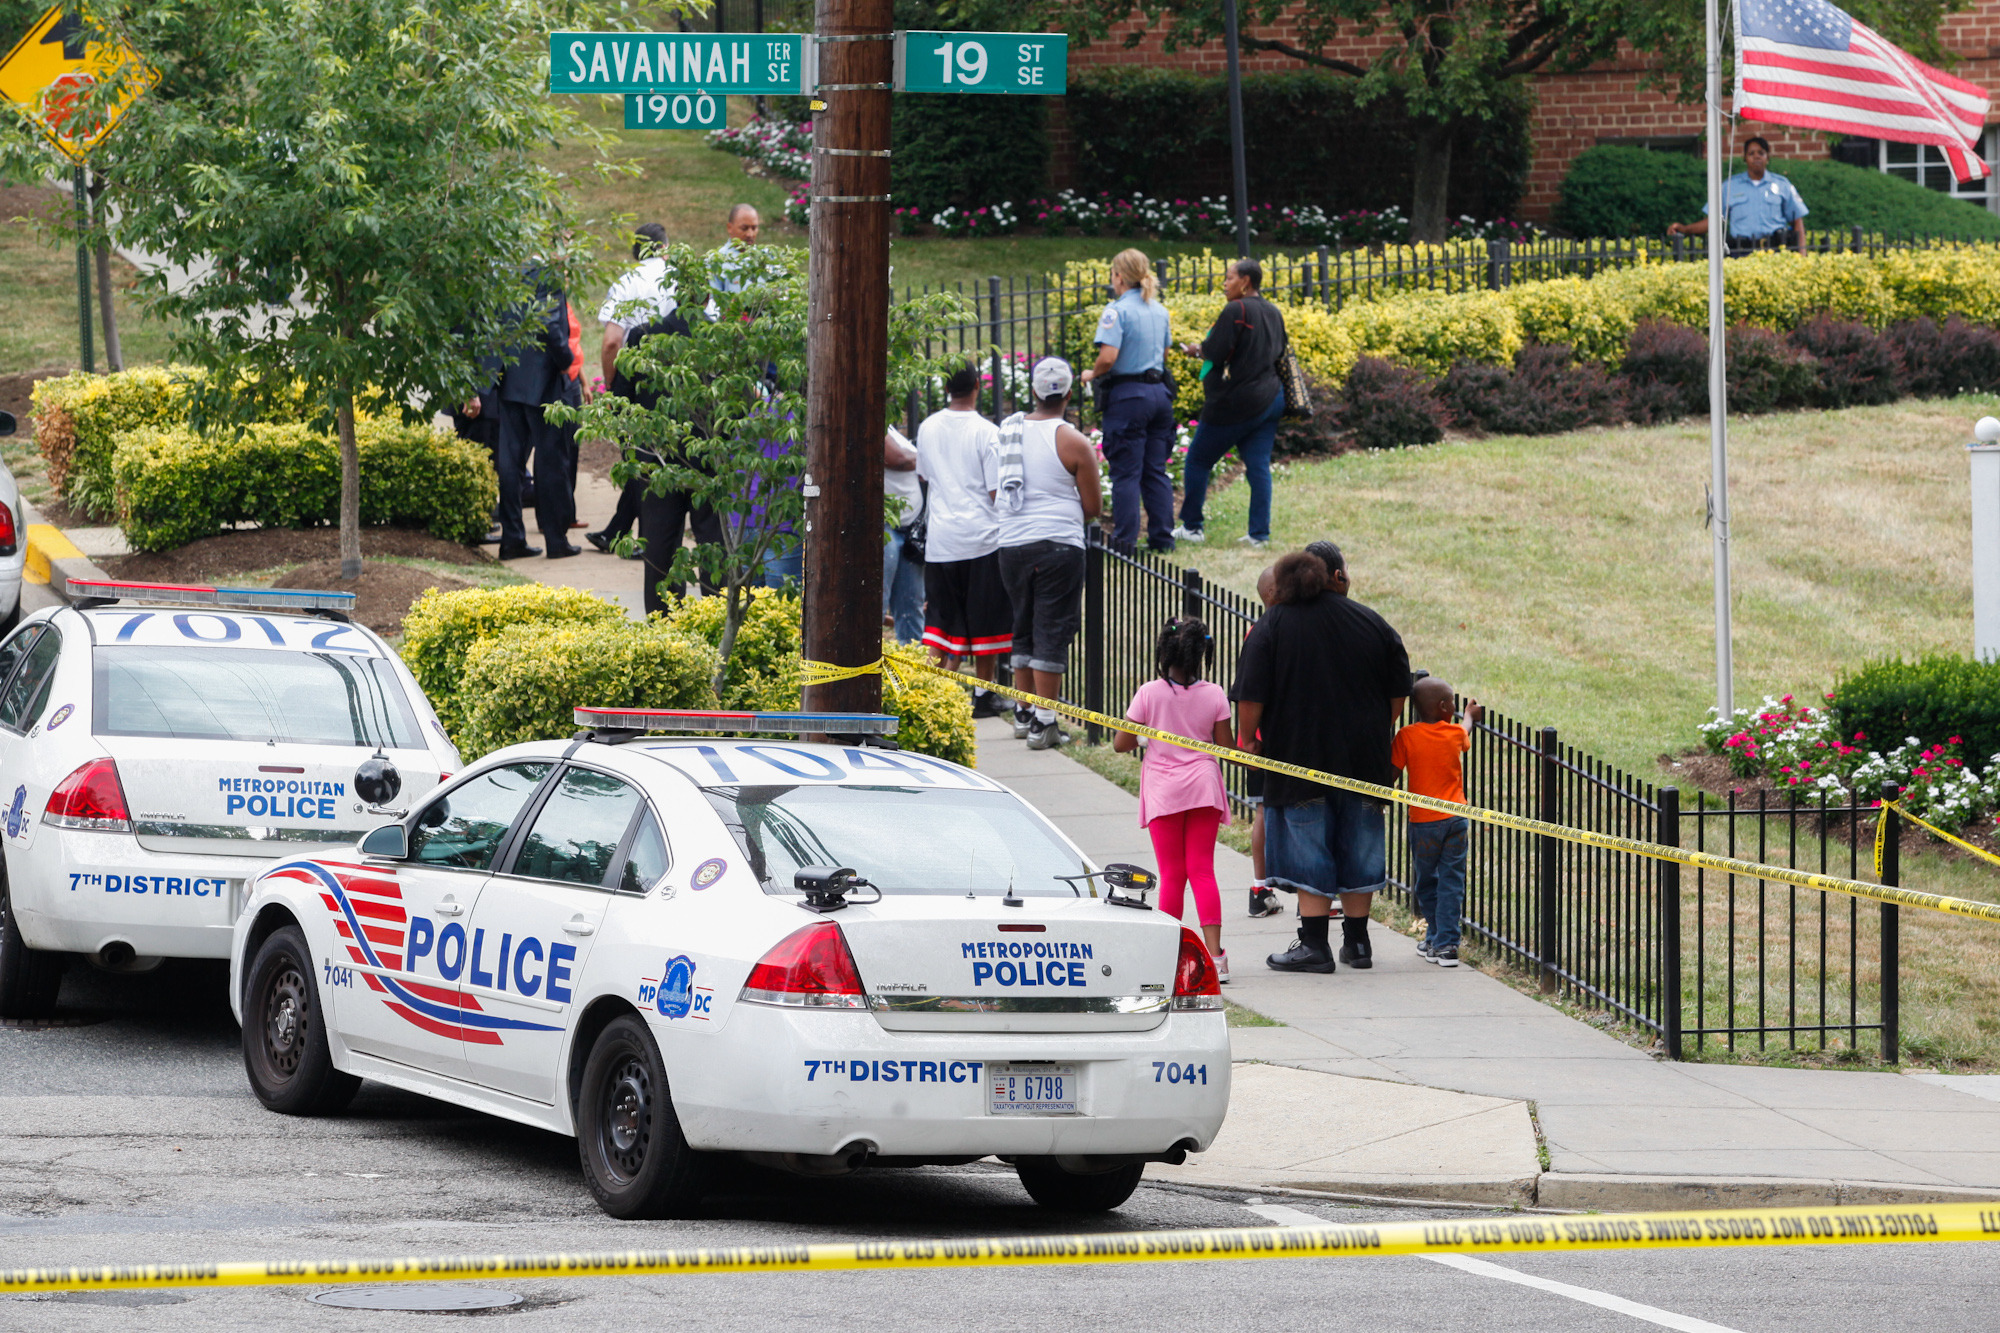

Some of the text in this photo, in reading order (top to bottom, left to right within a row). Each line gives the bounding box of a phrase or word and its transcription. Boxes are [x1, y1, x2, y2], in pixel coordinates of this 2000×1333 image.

[569, 41, 750, 83] SAVANNAH
[767, 43, 791, 61] TER
[1018, 44, 1044, 62] ST
[767, 63, 790, 82] SE
[934, 41, 988, 85] 19
[1018, 66, 1044, 85] SE
[635, 95, 716, 124] 1900
[95, 613, 370, 654] 7012
[644, 746, 985, 787] 7041
[219, 778, 344, 796] METROPOLITAN
[227, 795, 335, 819] POLICE
[69, 873, 226, 897] 7TH DISTRICT
[406, 916, 577, 1004] POLICE
[961, 942, 1093, 959] METROPOLITAN
[324, 965, 353, 989] 7041
[973, 961, 1087, 987] POLICE
[638, 984, 656, 1003] MP
[876, 983, 927, 992] IMPALA
[694, 993, 712, 1013] DC
[804, 1060, 983, 1083] 7TH DISTRICT
[1152, 1061, 1207, 1085] 7041
[1025, 1077, 1063, 1100] 6798
[1319, 1228, 1381, 1250] POLICE
[1424, 1213, 1938, 1245] POLICE LINE DO NOT CROSS CRIME SOLVERS 1-800-673-2777
[1001, 1238, 1078, 1257] SOLVERS
[1083, 1235, 1140, 1256] CRIME
[1143, 1233, 1205, 1254] CROSS
[1210, 1233, 1246, 1253] NOT
[1248, 1232, 1274, 1252] DO
[1278, 1231, 1316, 1251] LINE
